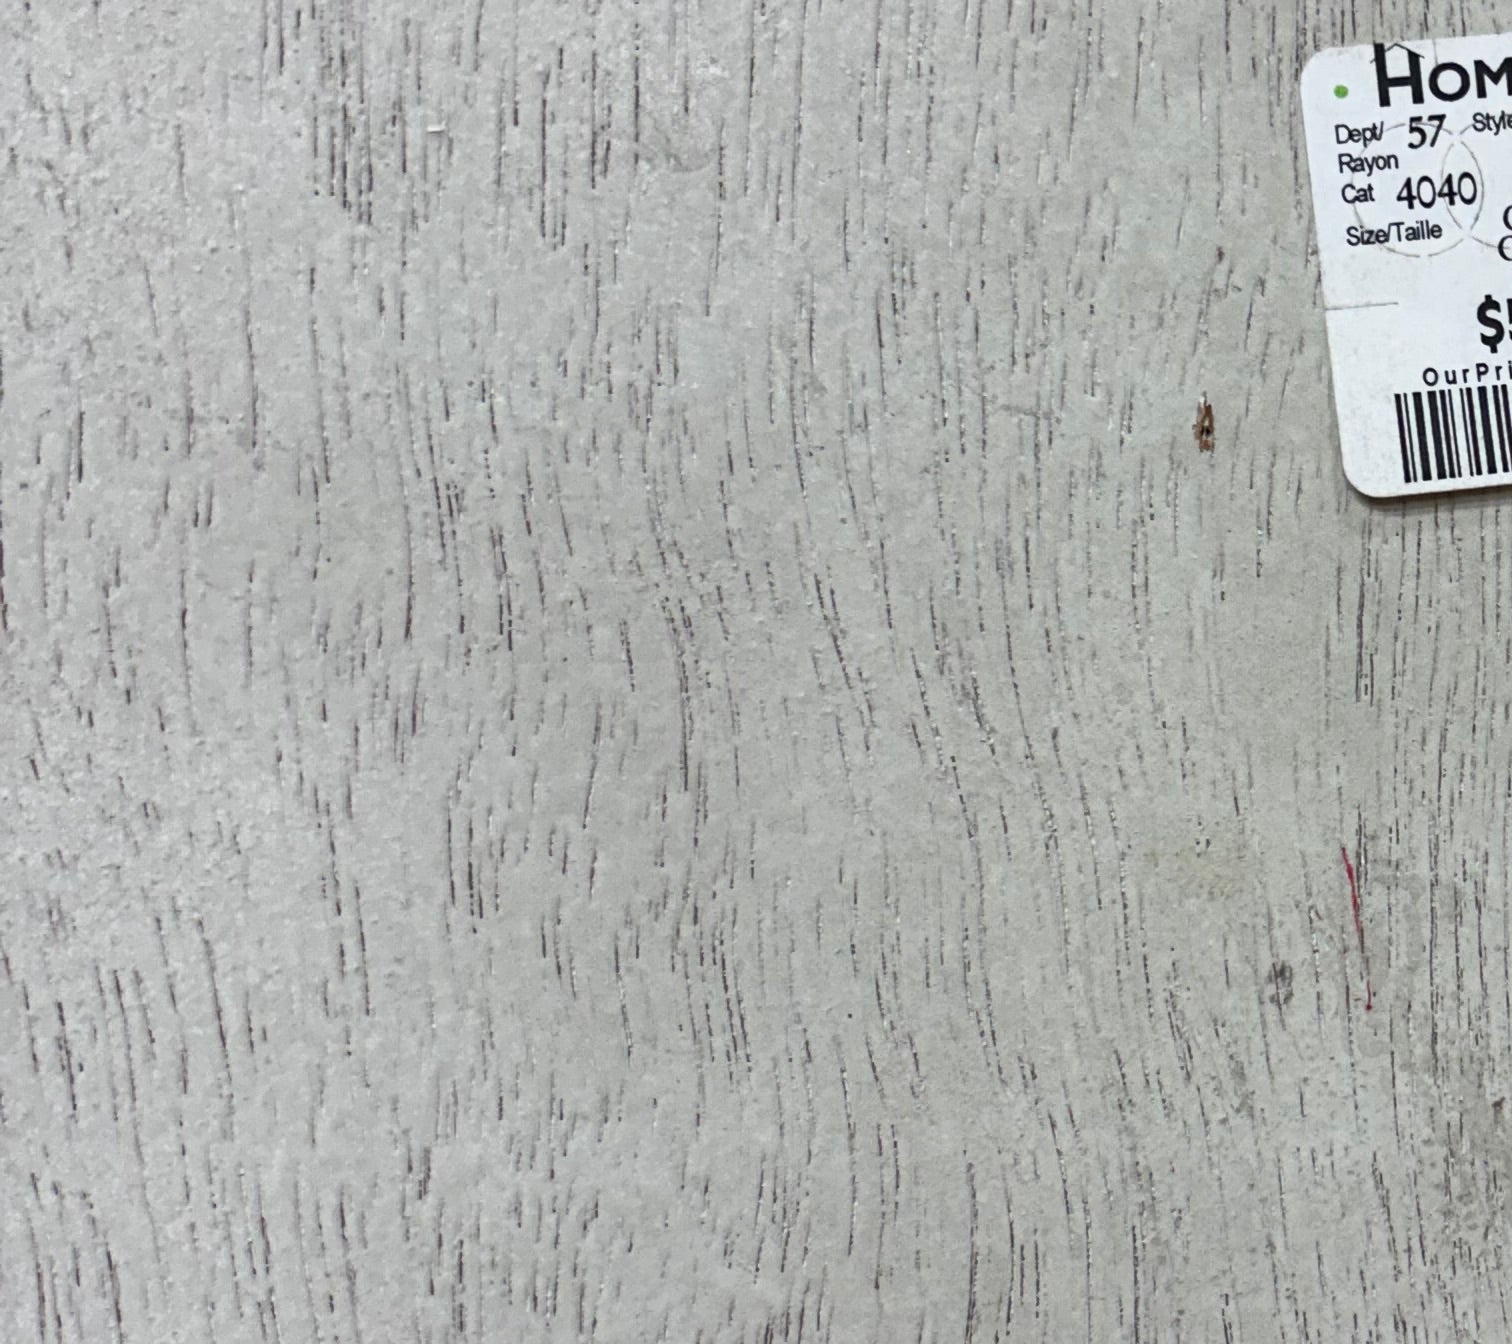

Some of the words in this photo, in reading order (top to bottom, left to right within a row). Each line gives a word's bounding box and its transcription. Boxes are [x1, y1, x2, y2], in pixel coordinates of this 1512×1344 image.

[1335, 121, 1385, 145] Dept/
[1407, 114, 1446, 148] 57
[1338, 152, 1399, 176] Rayon
[1341, 184, 1375, 204] Cat
[1396, 172, 1478, 210] 4040
[1346, 221, 1443, 247] Size/Taille
